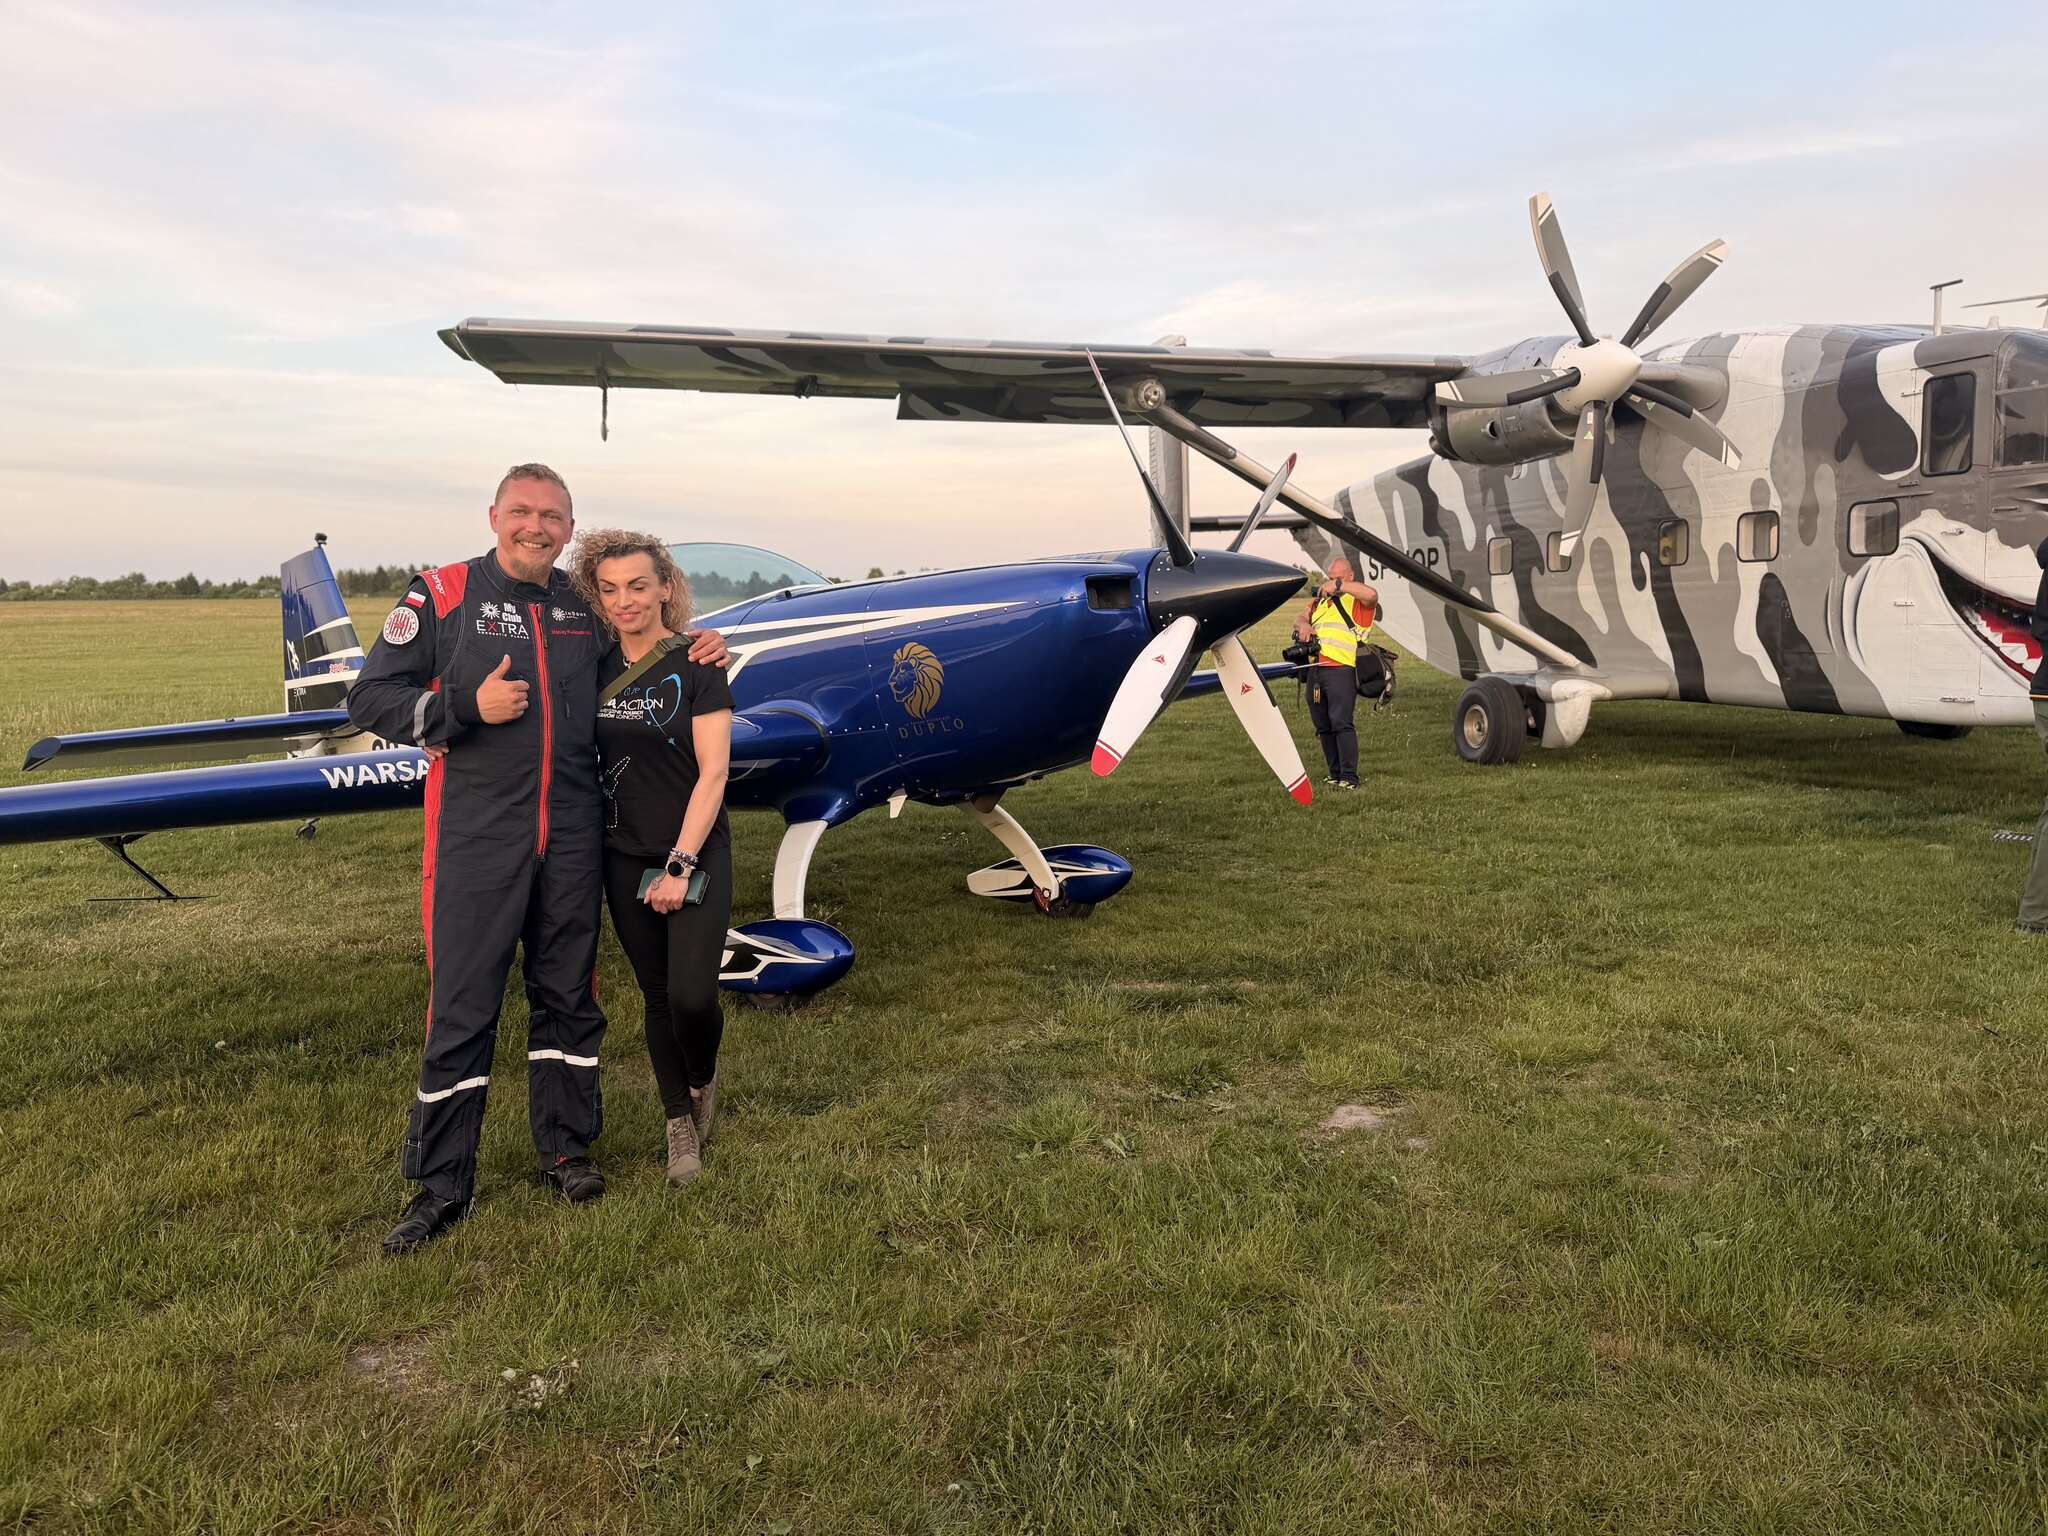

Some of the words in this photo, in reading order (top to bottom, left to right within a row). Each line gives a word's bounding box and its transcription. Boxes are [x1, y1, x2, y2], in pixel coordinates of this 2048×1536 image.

[503, 602, 517, 614] My
[502, 612, 522, 623] Club
[476, 619, 529, 636] EXTRA
[898, 717, 964, 739] DUPLO
